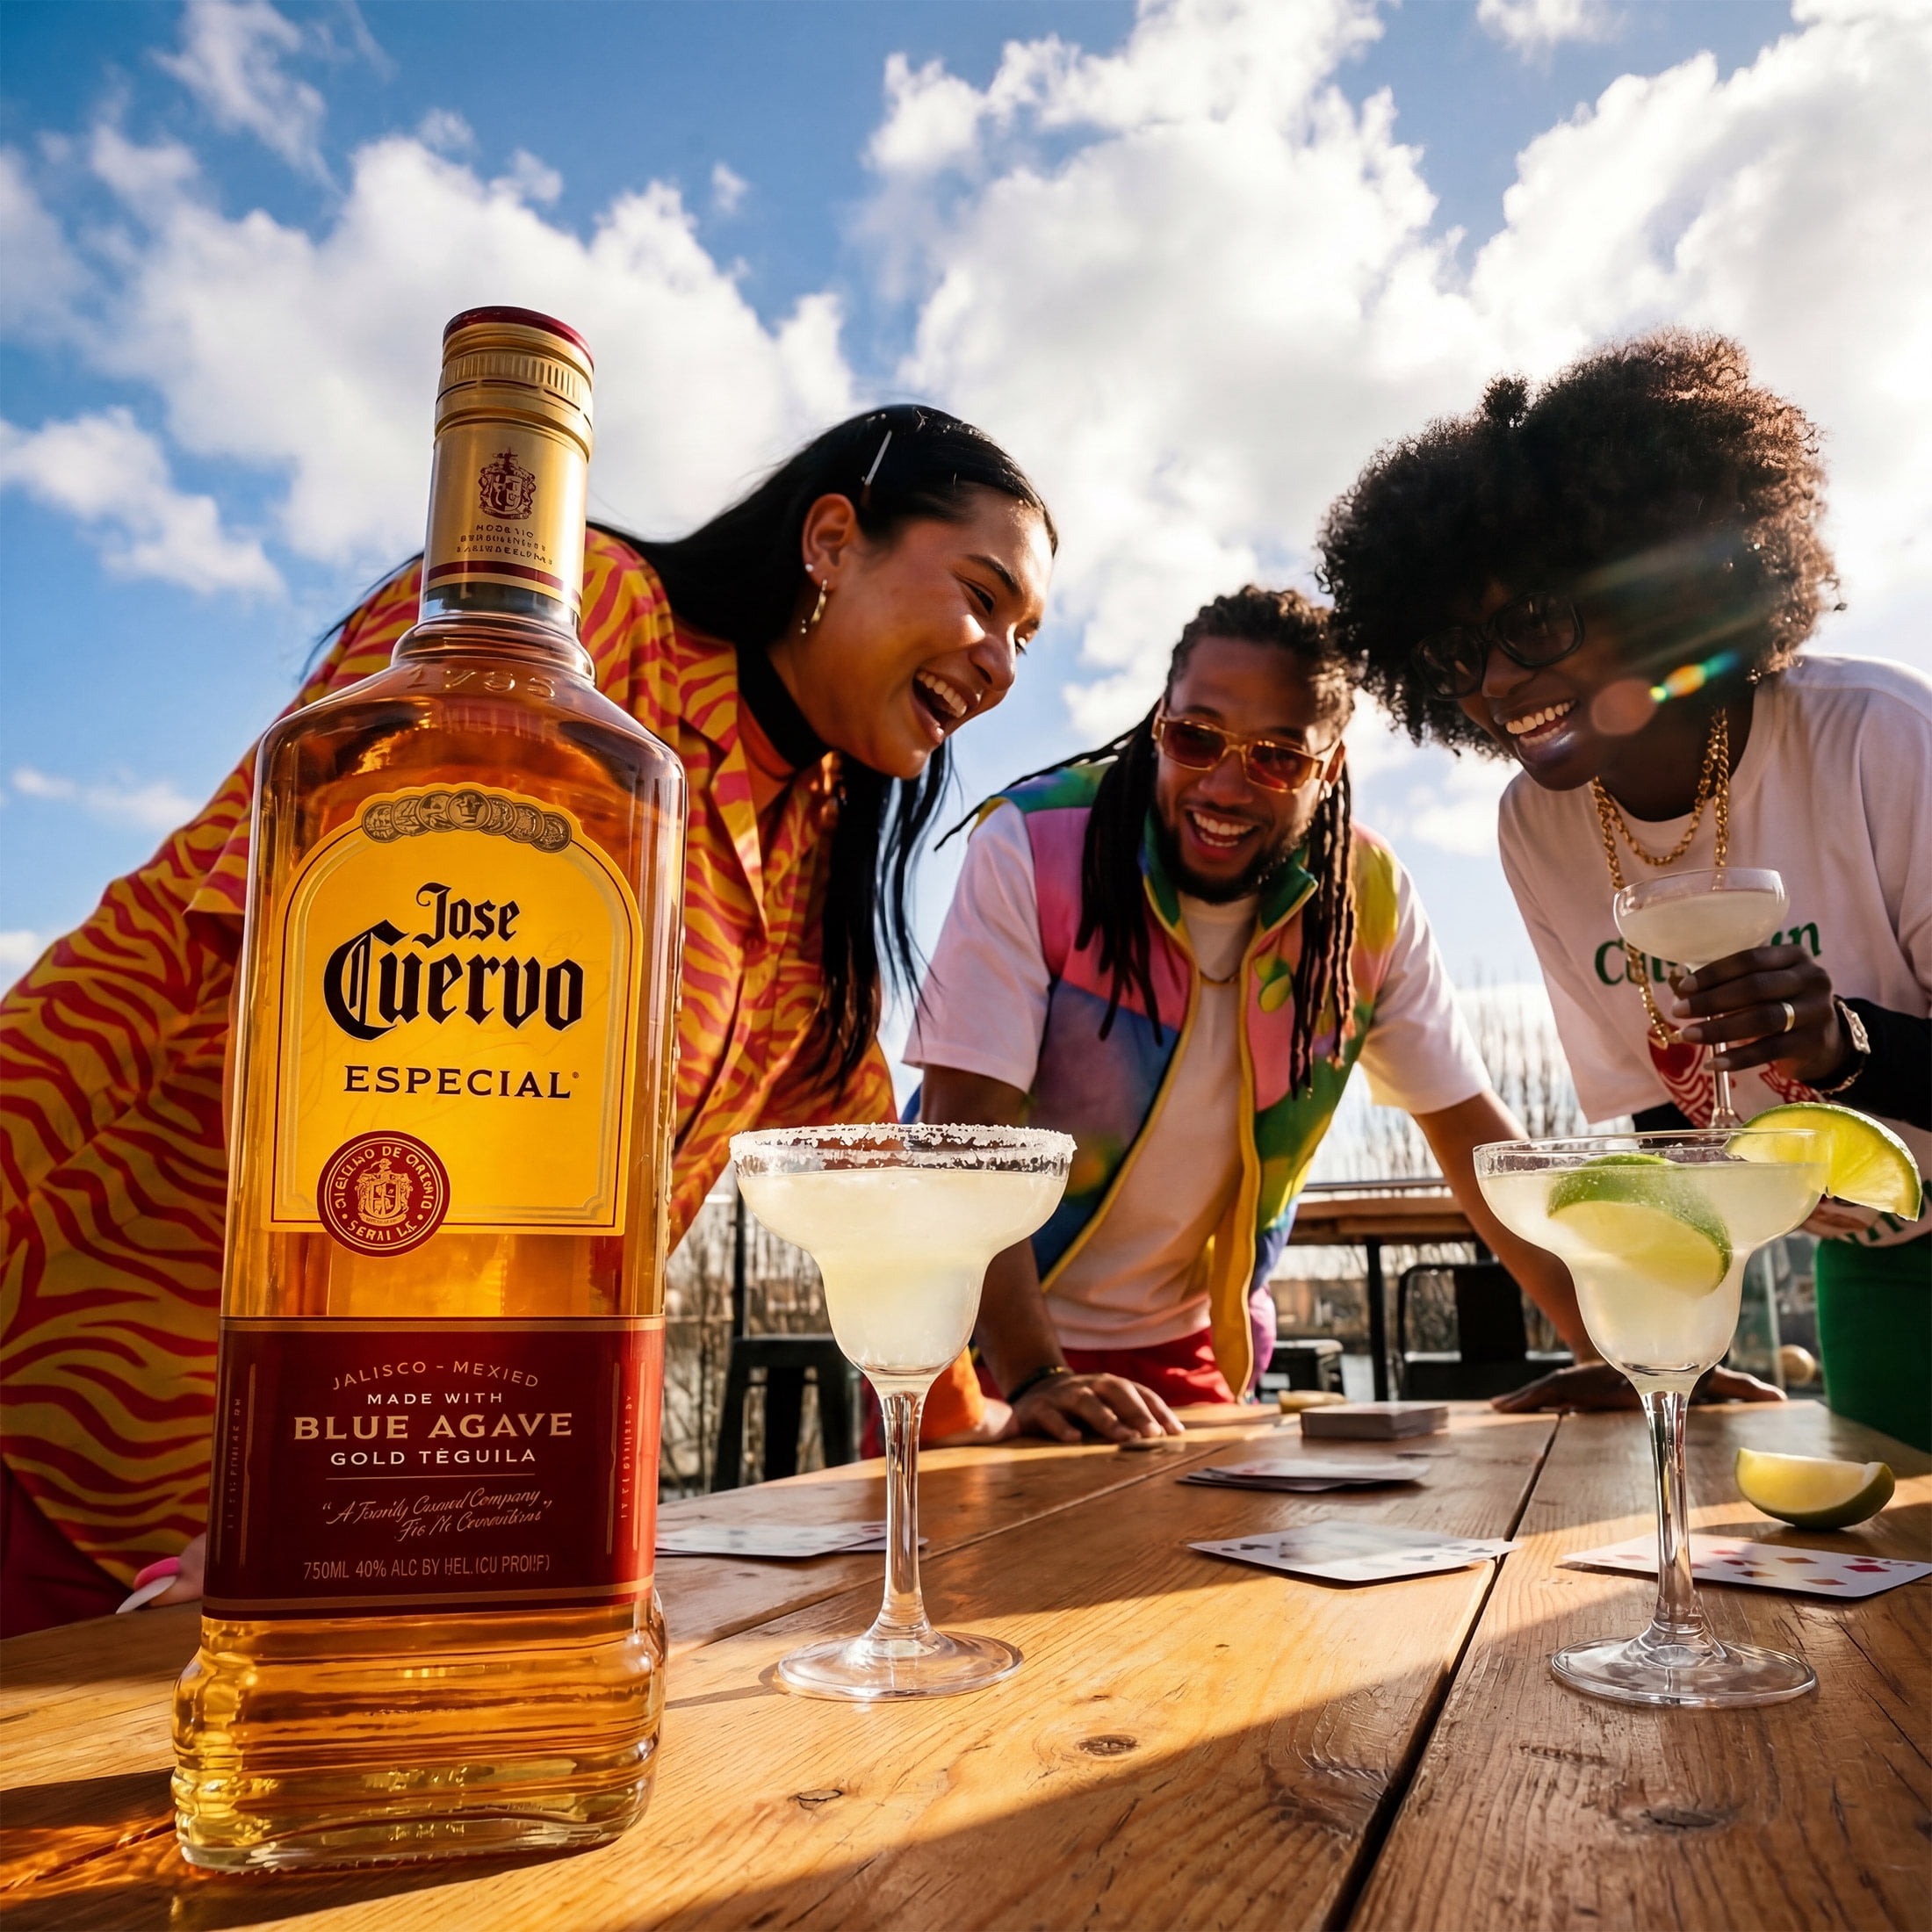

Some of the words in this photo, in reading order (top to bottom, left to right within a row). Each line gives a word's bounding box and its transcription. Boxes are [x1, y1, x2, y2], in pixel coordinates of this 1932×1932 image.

[412, 882, 520, 948] Jose
[323, 919, 583, 1042] Cuervo
[343, 1065, 571, 1099] ESPECIAL
[382, 1145, 402, 1158] DE
[333, 1361, 426, 1390] JALISCO
[453, 1360, 538, 1388] MEXIED
[367, 1393, 432, 1405] MADE
[444, 1392, 502, 1404] WITH
[294, 1415, 409, 1440] BLUE
[428, 1412, 573, 1438] AGAVE
[330, 1451, 405, 1466] GOLD
[304, 1560, 350, 1580] 750ML
[355, 1559, 387, 1578] 40%
[390, 1558, 418, 1576] ALC
[422, 1557, 441, 1575] BY
